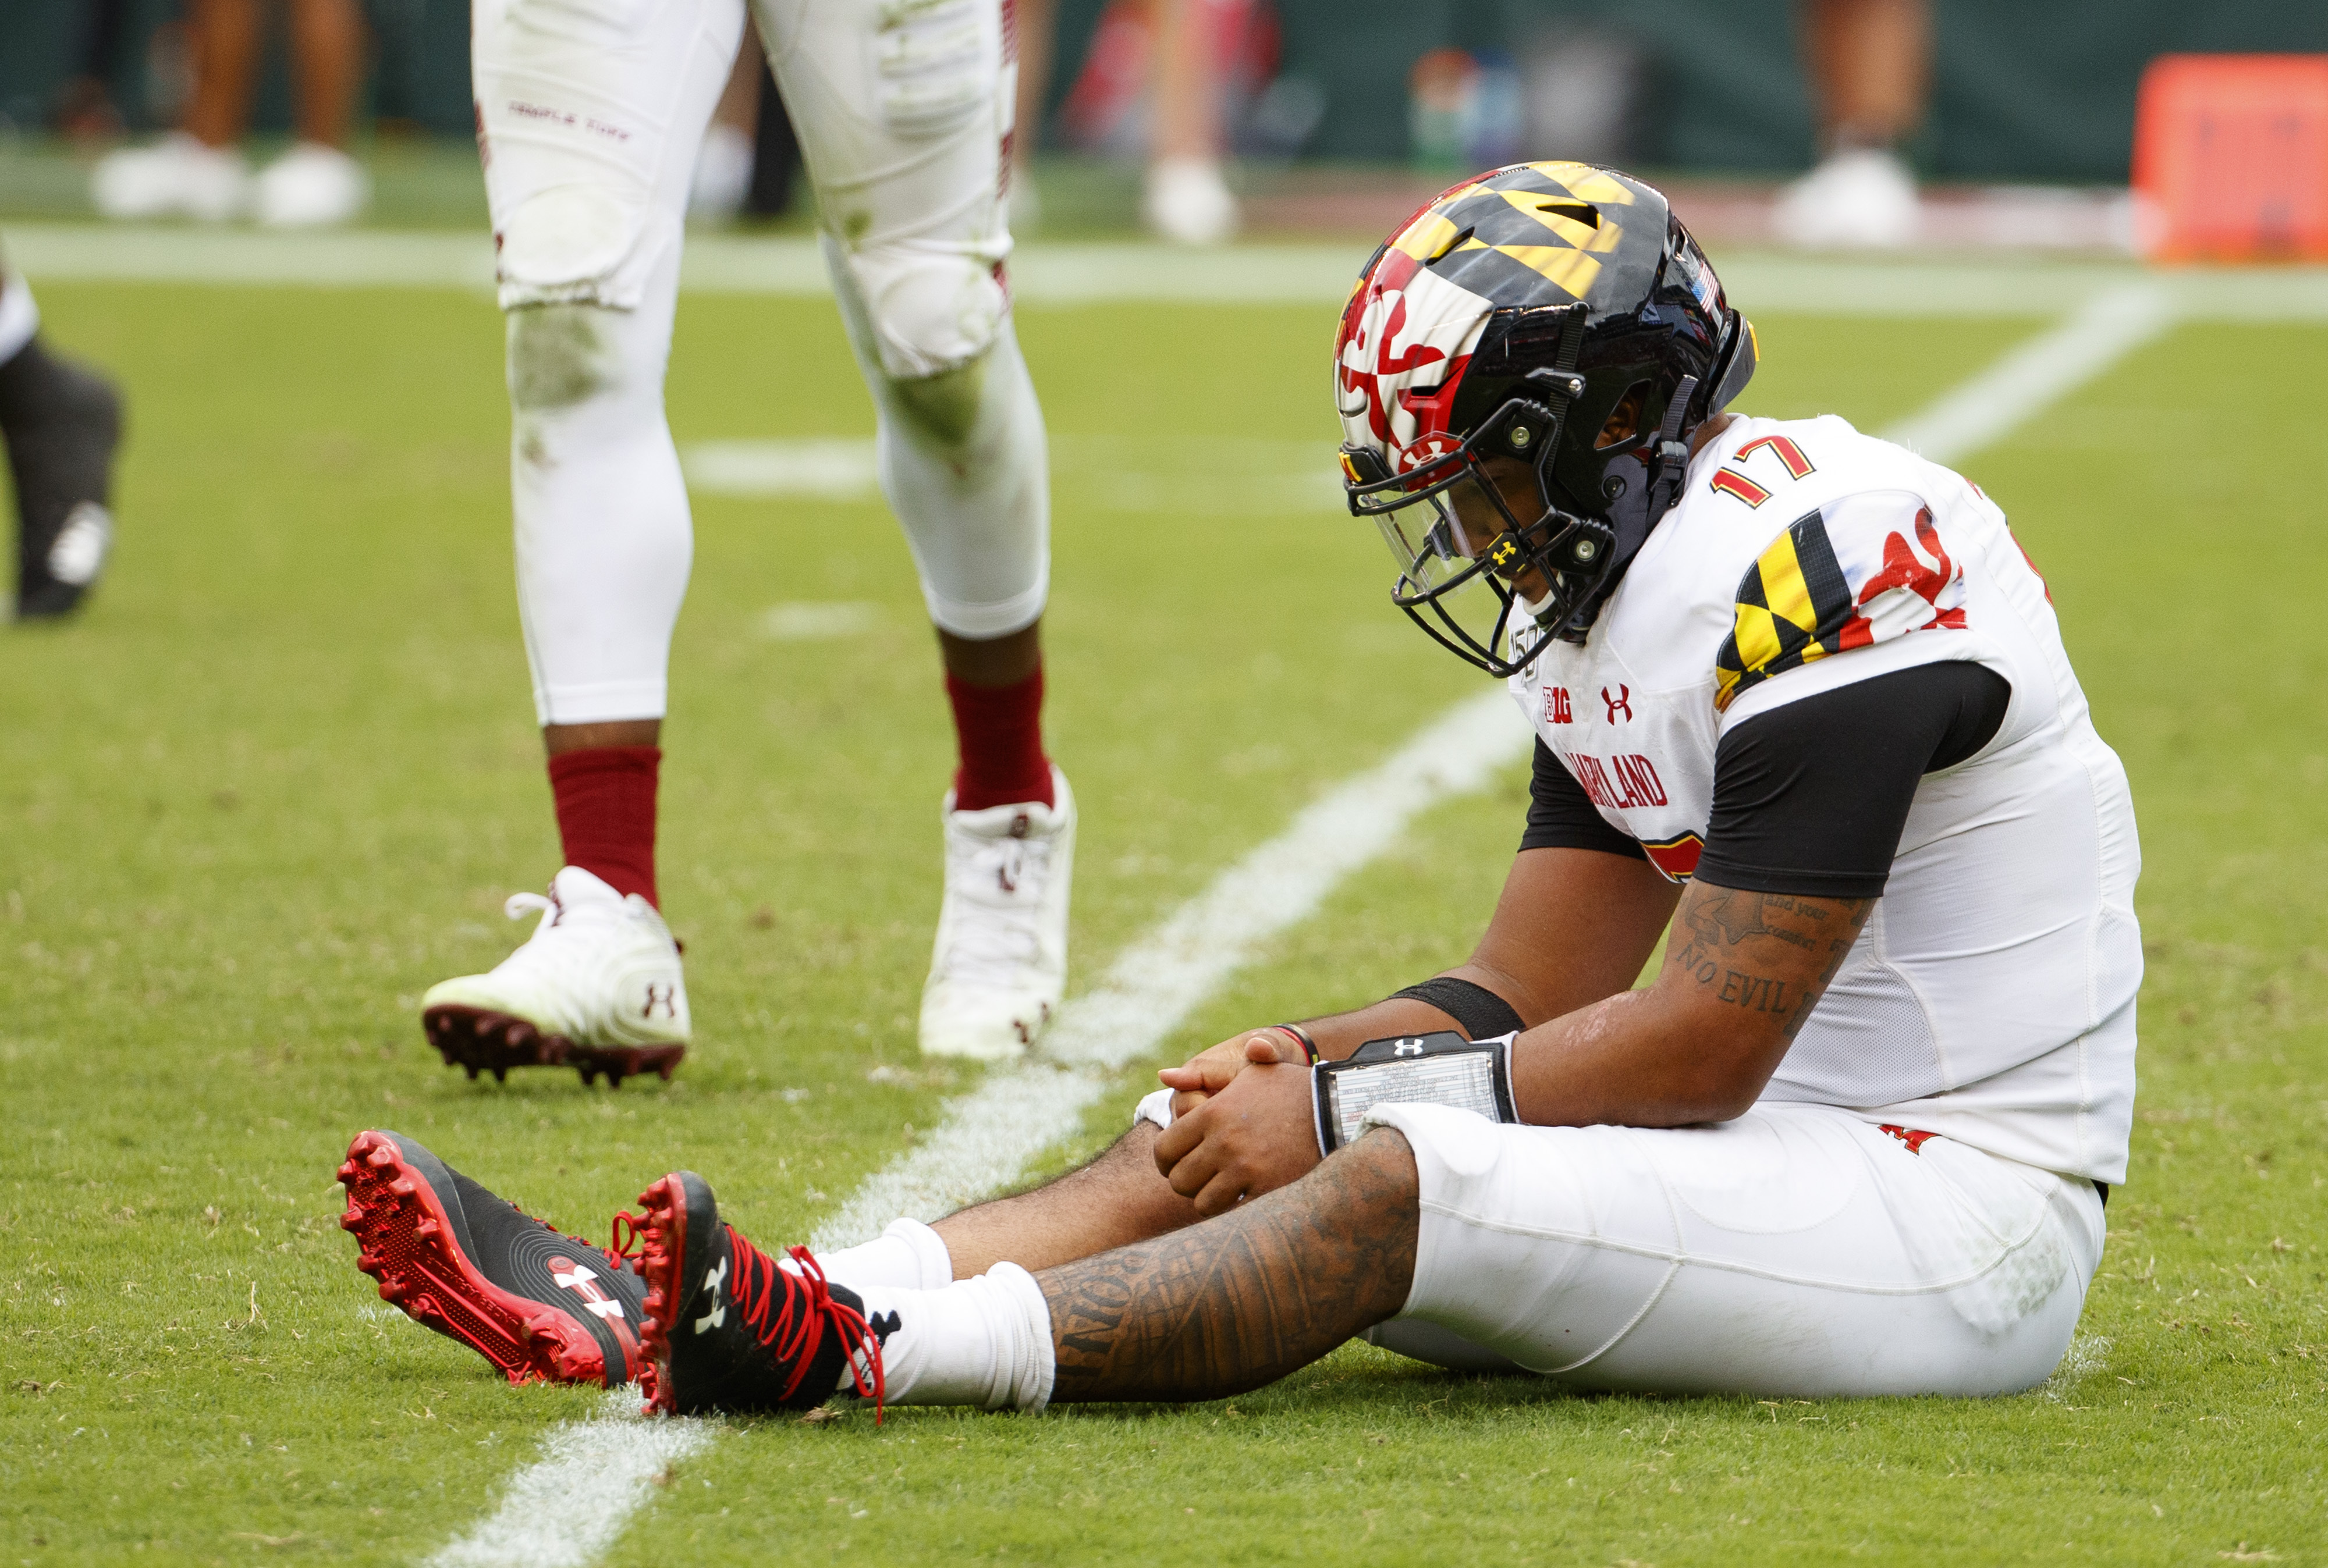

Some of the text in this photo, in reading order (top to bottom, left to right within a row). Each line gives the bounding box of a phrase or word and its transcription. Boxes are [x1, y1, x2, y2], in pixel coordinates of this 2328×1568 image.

[1709, 435, 1816, 510] 17
[1676, 944, 1787, 1014] NO EVIL
